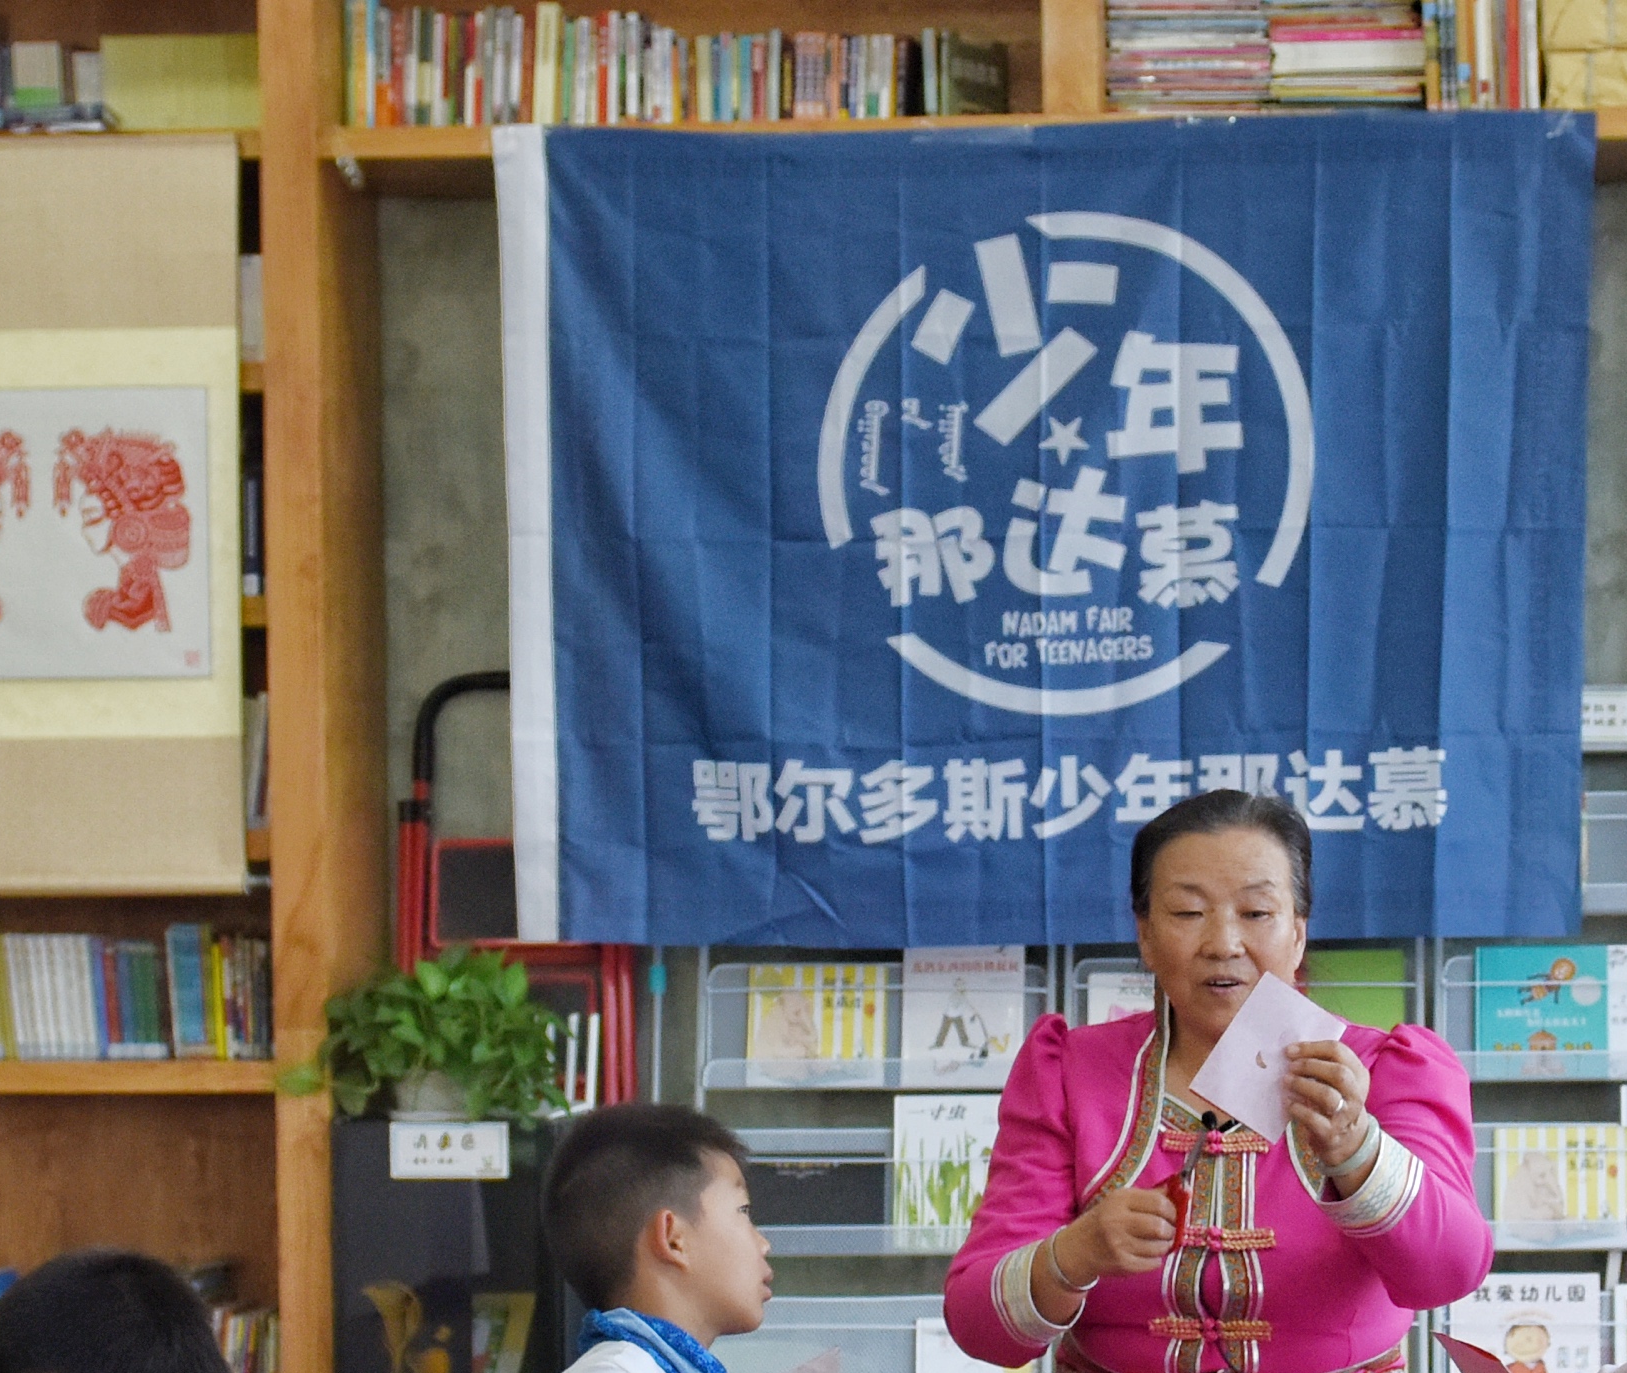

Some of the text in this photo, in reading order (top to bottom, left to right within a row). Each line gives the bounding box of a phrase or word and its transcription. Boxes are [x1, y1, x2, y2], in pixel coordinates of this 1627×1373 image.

[870, 465, 1240, 608] 那达慕
[1002, 604, 1134, 640] NADAM FAIR
[984, 634, 1154, 669] FOR TEENAGERS
[1474, 1283, 1586, 1303] 我爱幼儿园
